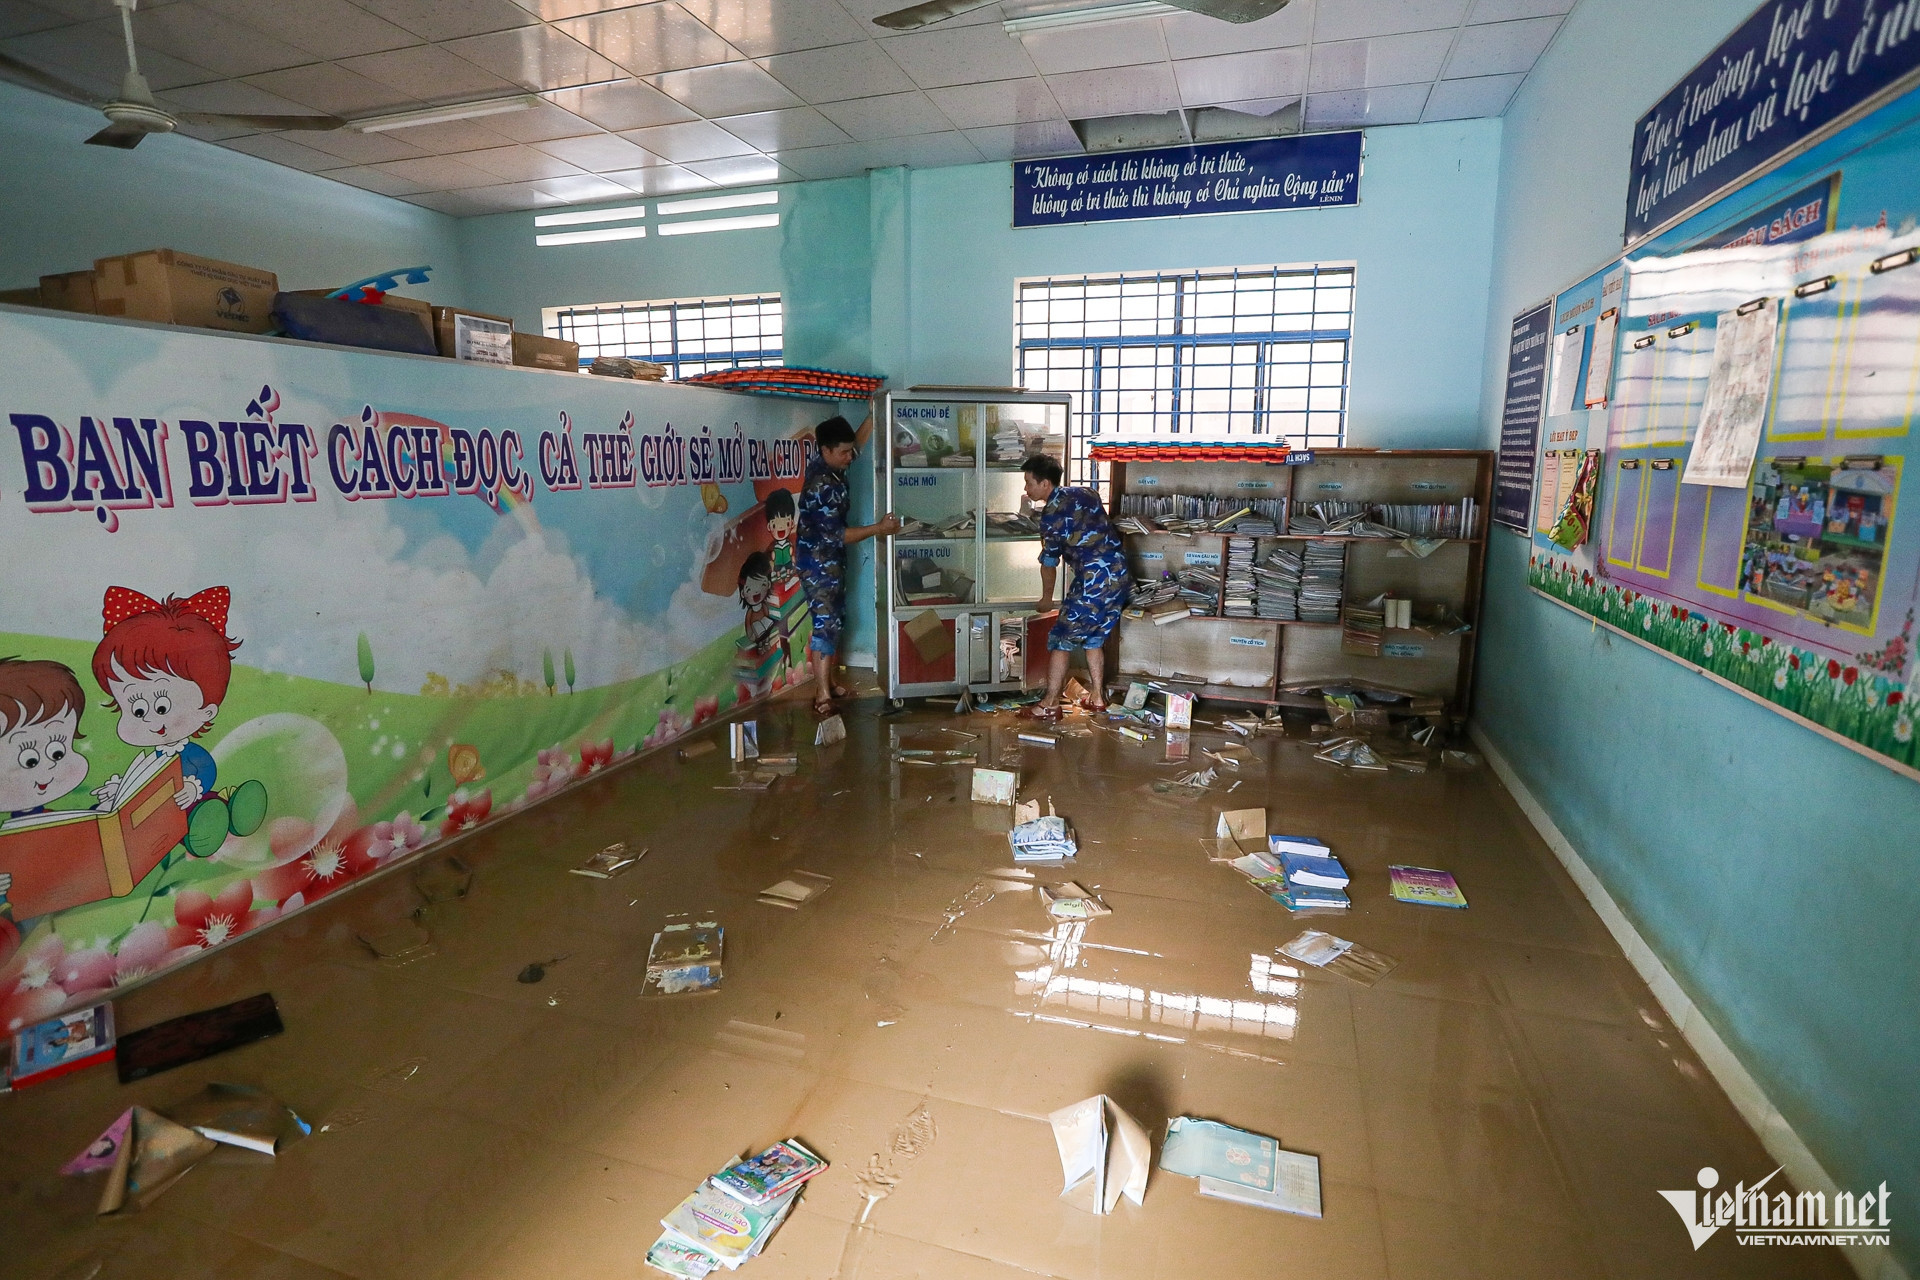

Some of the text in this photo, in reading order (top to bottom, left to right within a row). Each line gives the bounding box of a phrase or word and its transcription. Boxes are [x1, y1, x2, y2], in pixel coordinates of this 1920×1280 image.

[1641, 0, 1814, 166] Học ở trường, học
[1635, 174, 1660, 222] học
[1663, 141, 1689, 198] lẫn
[1692, 117, 1743, 177] nhau
[1746, 78, 1777, 141] và
[1784, 50, 1838, 121] học
[1076, 164, 1090, 185] có
[1092, 161, 1119, 184] sách
[1121, 159, 1139, 182] thì
[1140, 157, 1180, 183] không
[1183, 154, 1198, 176] có
[1200, 155, 1216, 175] tri
[1031, 193, 1069, 218] không
[1070, 190, 1084, 212] có
[1086, 191, 1101, 211] tri
[1103, 187, 1129, 209] thức
[1131, 185, 1150, 207] thì
[1152, 184, 1192, 209] không
[1195, 181, 1211, 202] có
[1214, 177, 1240, 202] Chủ
[1242, 175, 1281, 204] nghĩa
[1283, 173, 1318, 203] Cộng
[1319, 195, 1343, 203] LÊNIN
[1769, 198, 1823, 242] SÁCH
[897, 405, 918, 418] SÁCH
[921, 405, 936, 418] CHỦ
[9, 413, 172, 531] BẠN
[179, 384, 318, 507] BIẾT
[327, 403, 449, 501] CÁCH
[449, 427, 534, 508] ĐỌC,
[538, 410, 582, 492] CẢ
[583, 409, 637, 489] THẾ
[640, 421, 687, 487] GIỚI
[690, 425, 714, 485] SẼ
[718, 421, 745, 483] MỞ
[748, 437, 771, 480] RA
[773, 437, 800, 479] CHO
[1295, 453, 1310, 463] SÁCH
[898, 474, 937, 487] SÁCH MỚI
[898, 545, 951, 558] SÁCH TRA CỨU
